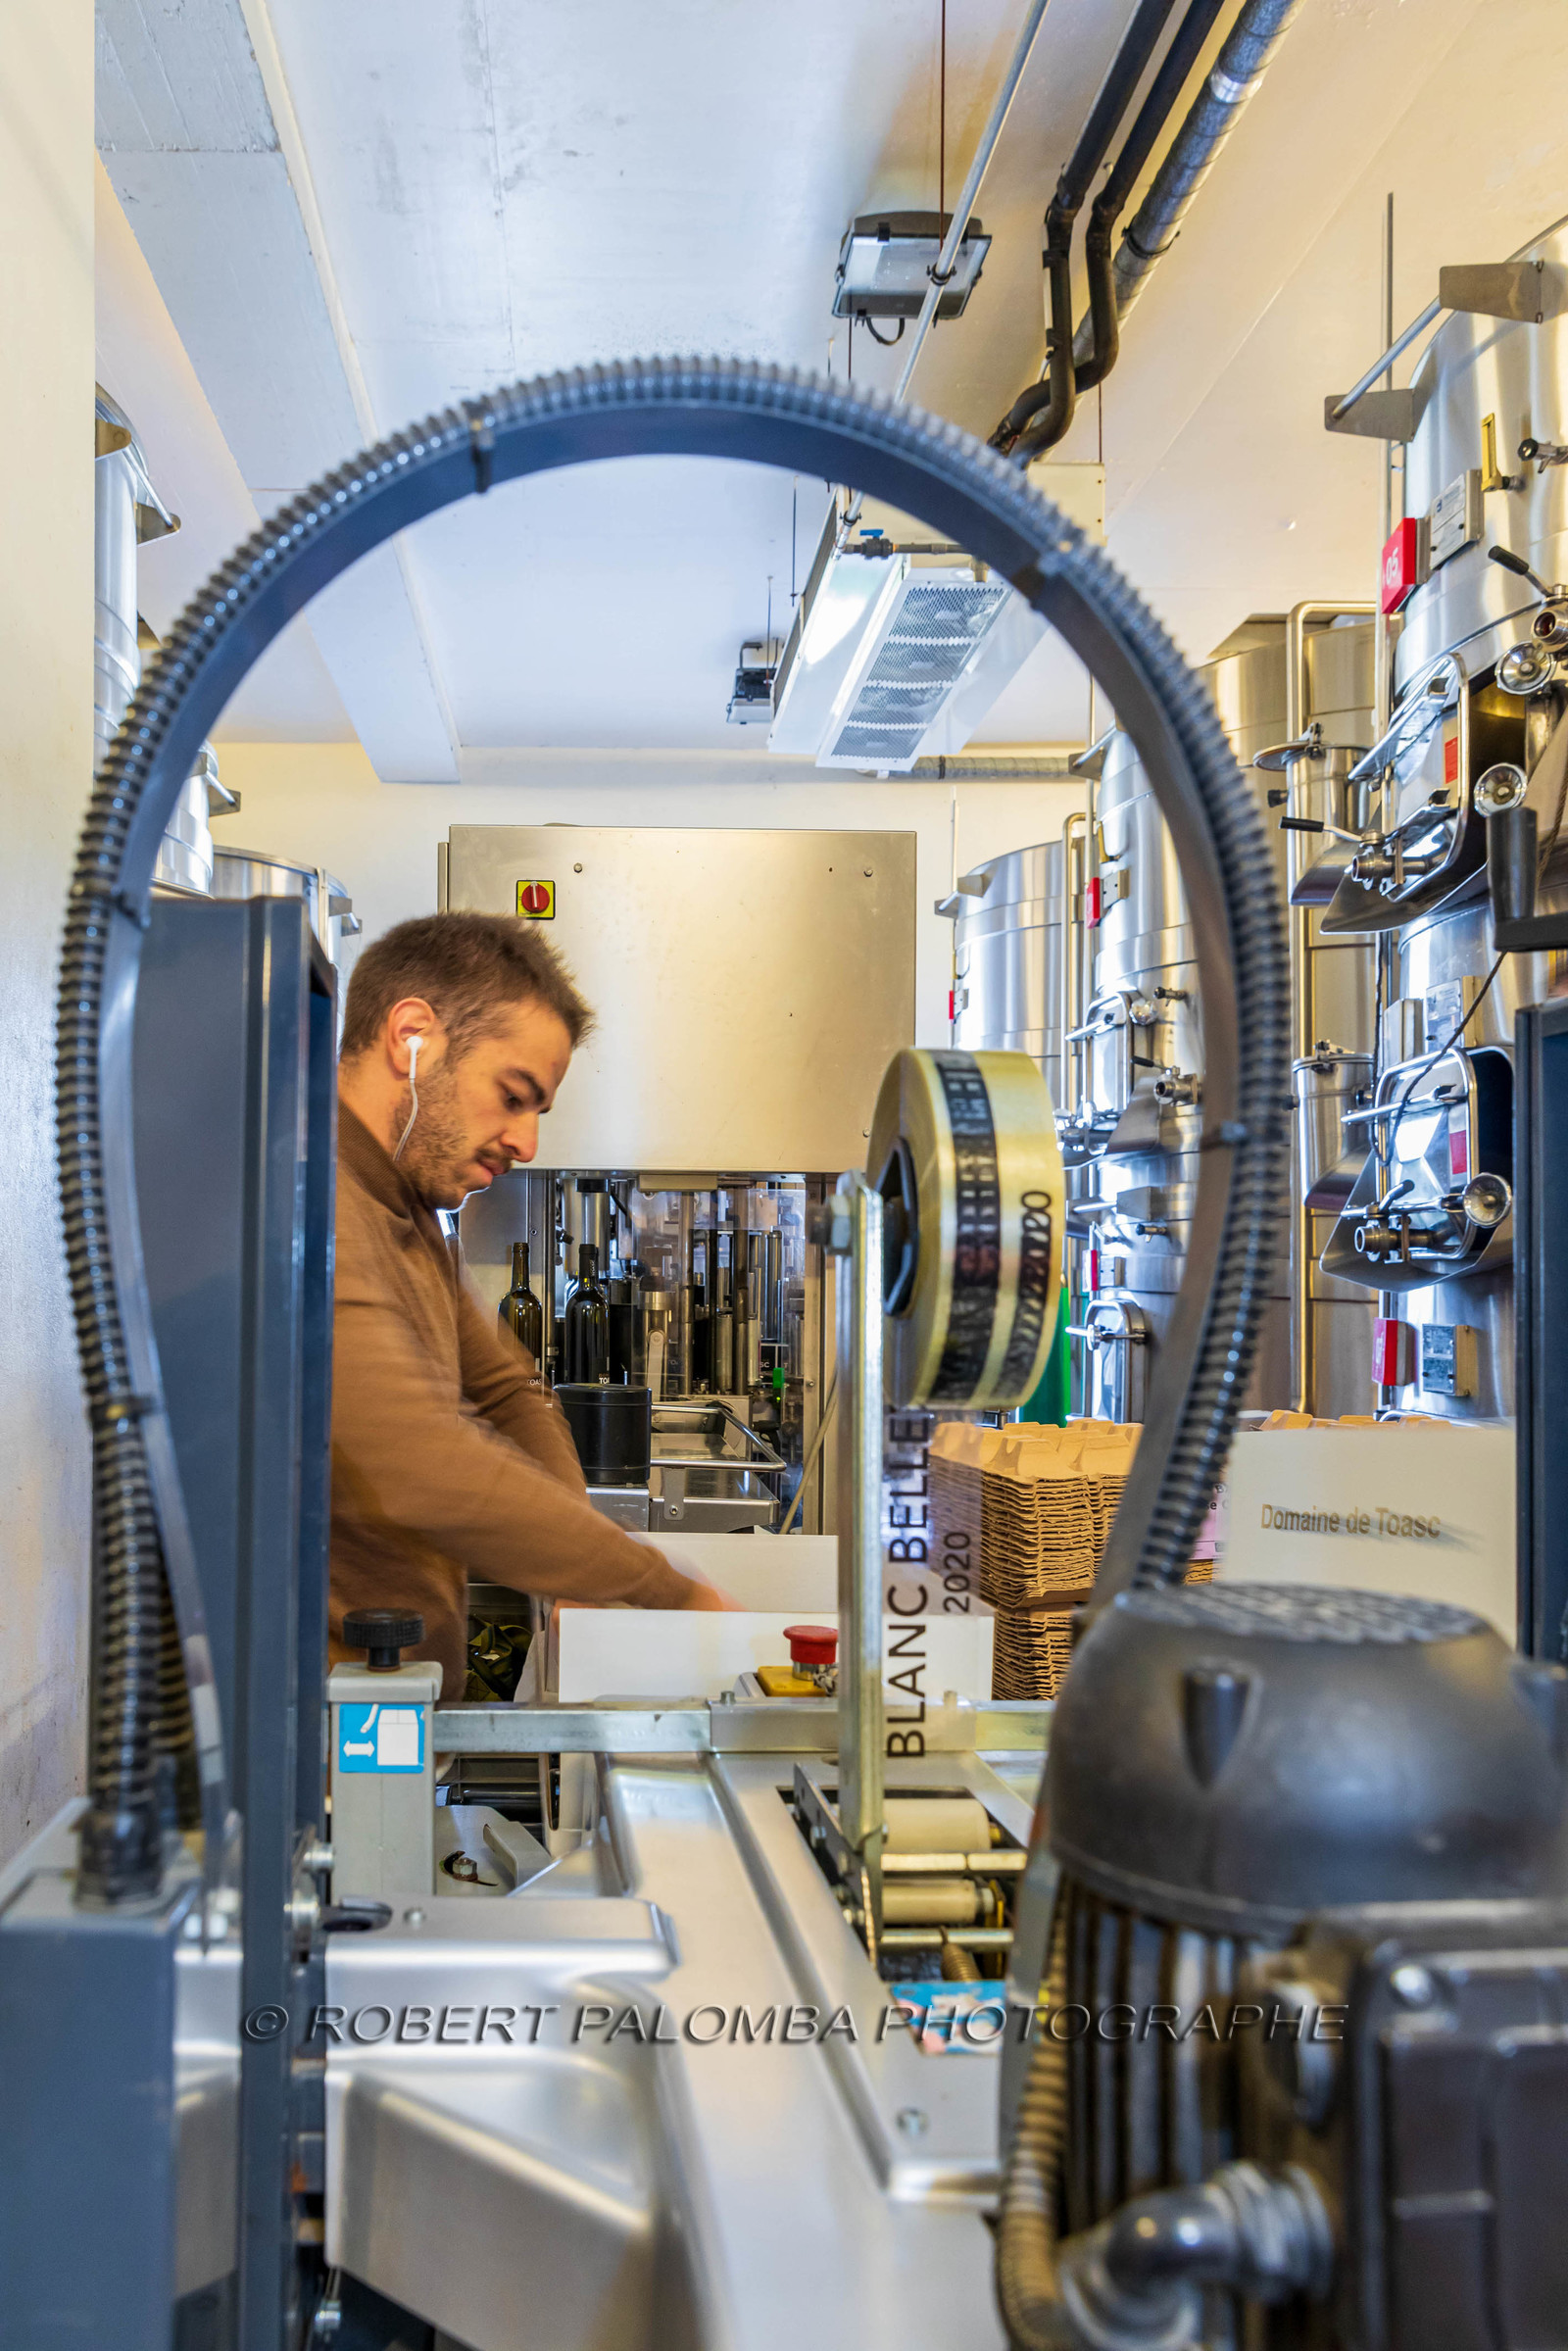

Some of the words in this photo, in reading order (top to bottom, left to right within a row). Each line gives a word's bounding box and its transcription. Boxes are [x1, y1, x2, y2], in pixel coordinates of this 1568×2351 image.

[889, 1417, 929, 1563] BELLE
[1260, 1503, 1341, 1533] Domaine
[1346, 1506, 1371, 1535] de
[1375, 1507, 1441, 1539] Toasc
[943, 1531, 971, 1613] 2020
[886, 1585, 928, 1758] BLANC
